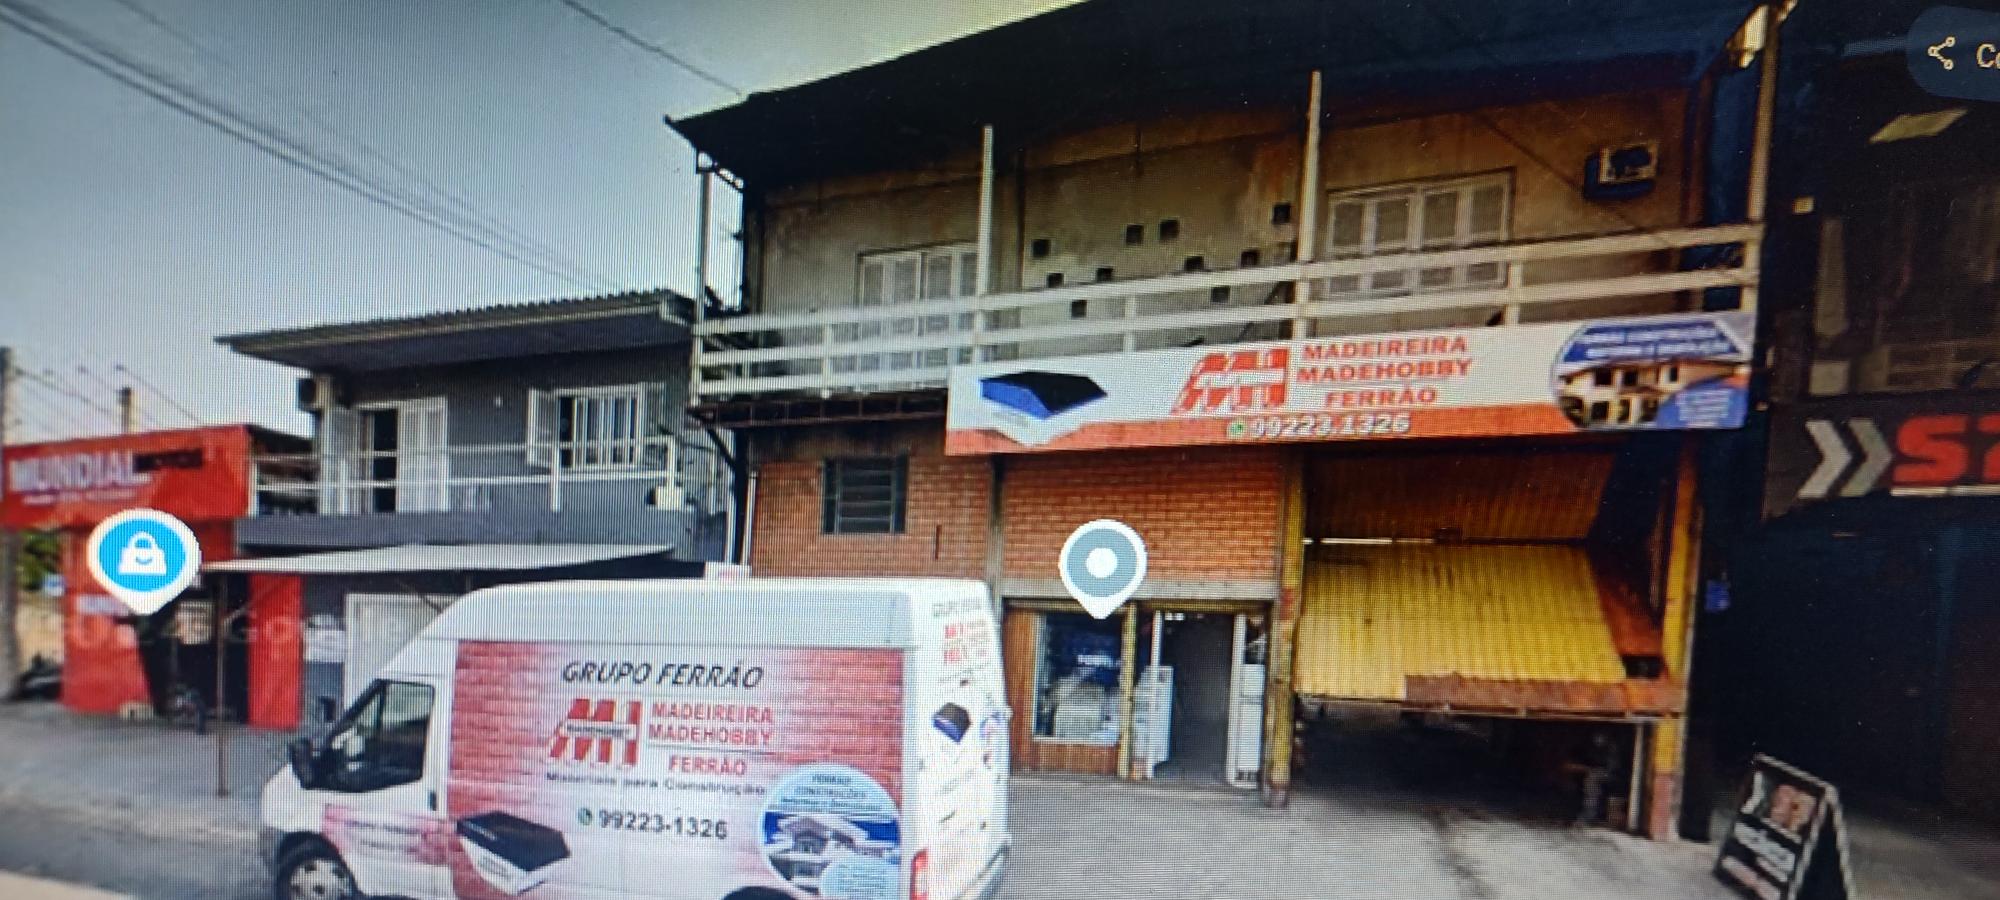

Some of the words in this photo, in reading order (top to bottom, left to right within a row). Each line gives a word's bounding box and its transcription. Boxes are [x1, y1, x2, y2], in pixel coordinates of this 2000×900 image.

[1302, 335, 1470, 360] MADEIREIRA
[1297, 358, 1474, 383] MADEHOBBY
[1324, 384, 1439, 408] FERRÃO
[562, 660, 651, 685] GRUPO
[656, 659, 765, 689] FERRÃO
[652, 702, 775, 723] MADEIREIRA
[649, 723, 775, 746] MADEHOBBY
[668, 754, 747, 776] FERRÃO
[546, 772, 617, 785] Materiais
[622, 777, 658, 790] para
[664, 777, 766, 796] Construção
